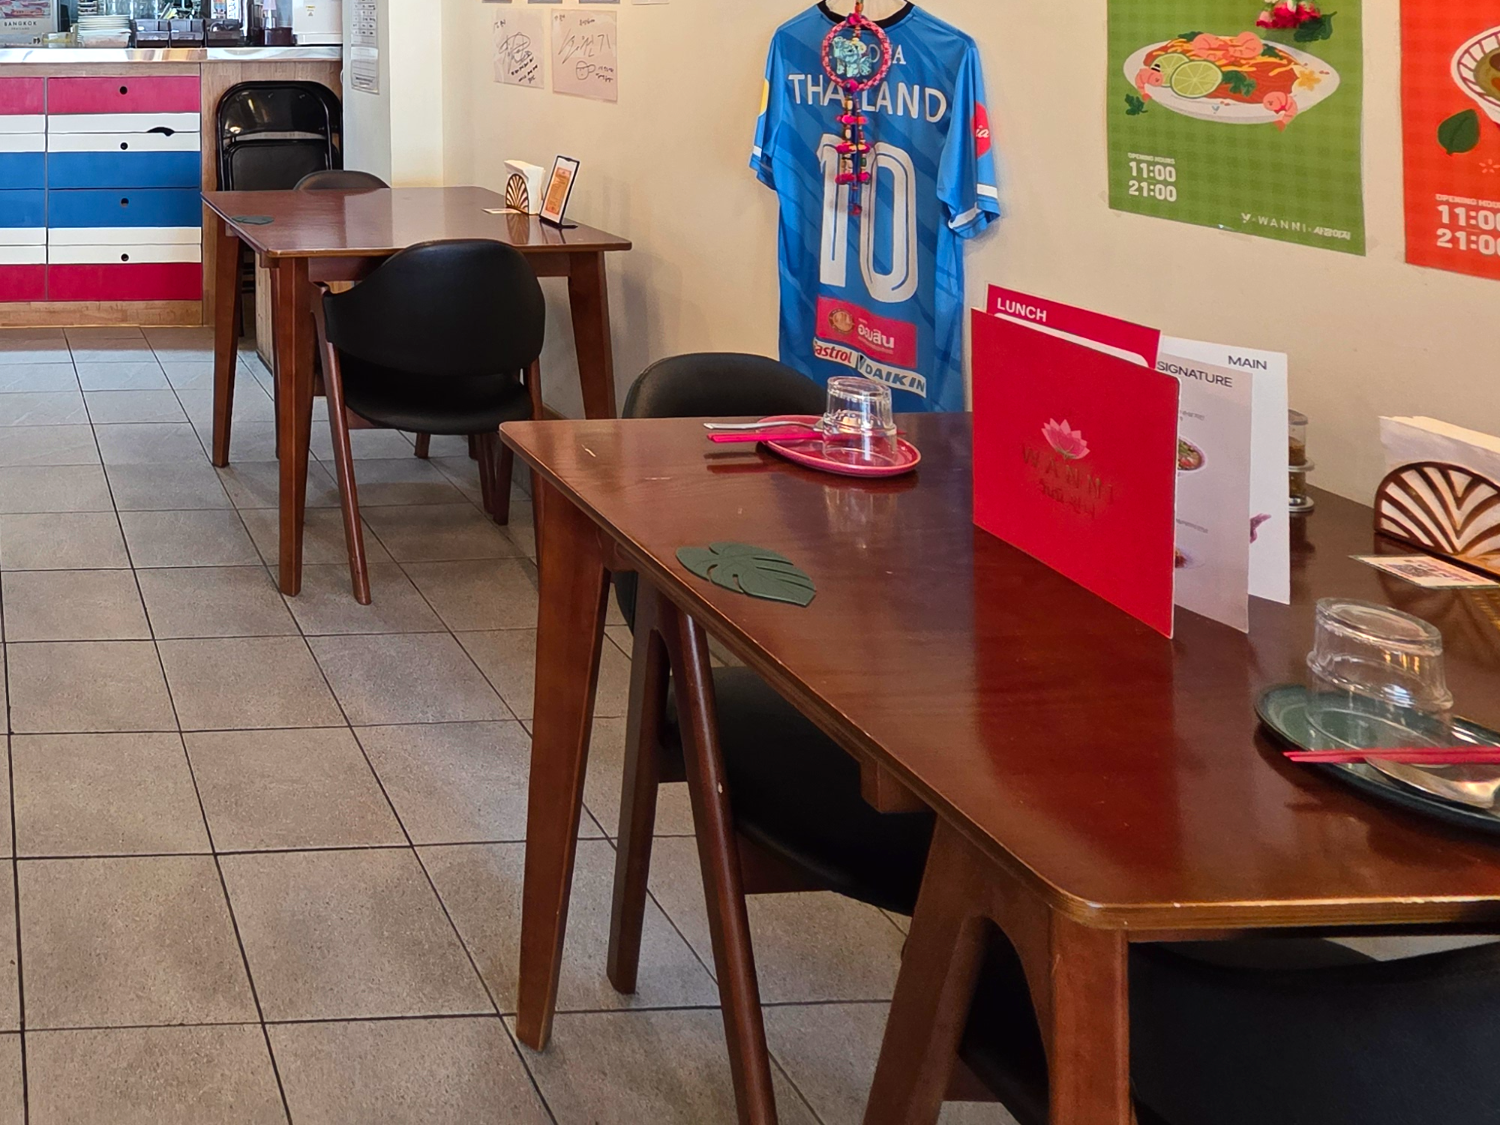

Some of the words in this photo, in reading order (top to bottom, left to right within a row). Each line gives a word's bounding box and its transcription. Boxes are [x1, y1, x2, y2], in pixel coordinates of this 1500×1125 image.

[788, 74, 947, 123] THALAND
[1129, 161, 1177, 182] 11:00
[1128, 179, 1178, 202] 21:00
[817, 133, 919, 304] 10
[1258, 215, 1308, 233] WANNI
[996, 297, 1048, 323] LUNCH
[1156, 359, 1234, 388] SIGNATURE
[1228, 355, 1268, 371] MAIN
[864, 361, 926, 393] DAIKIN
